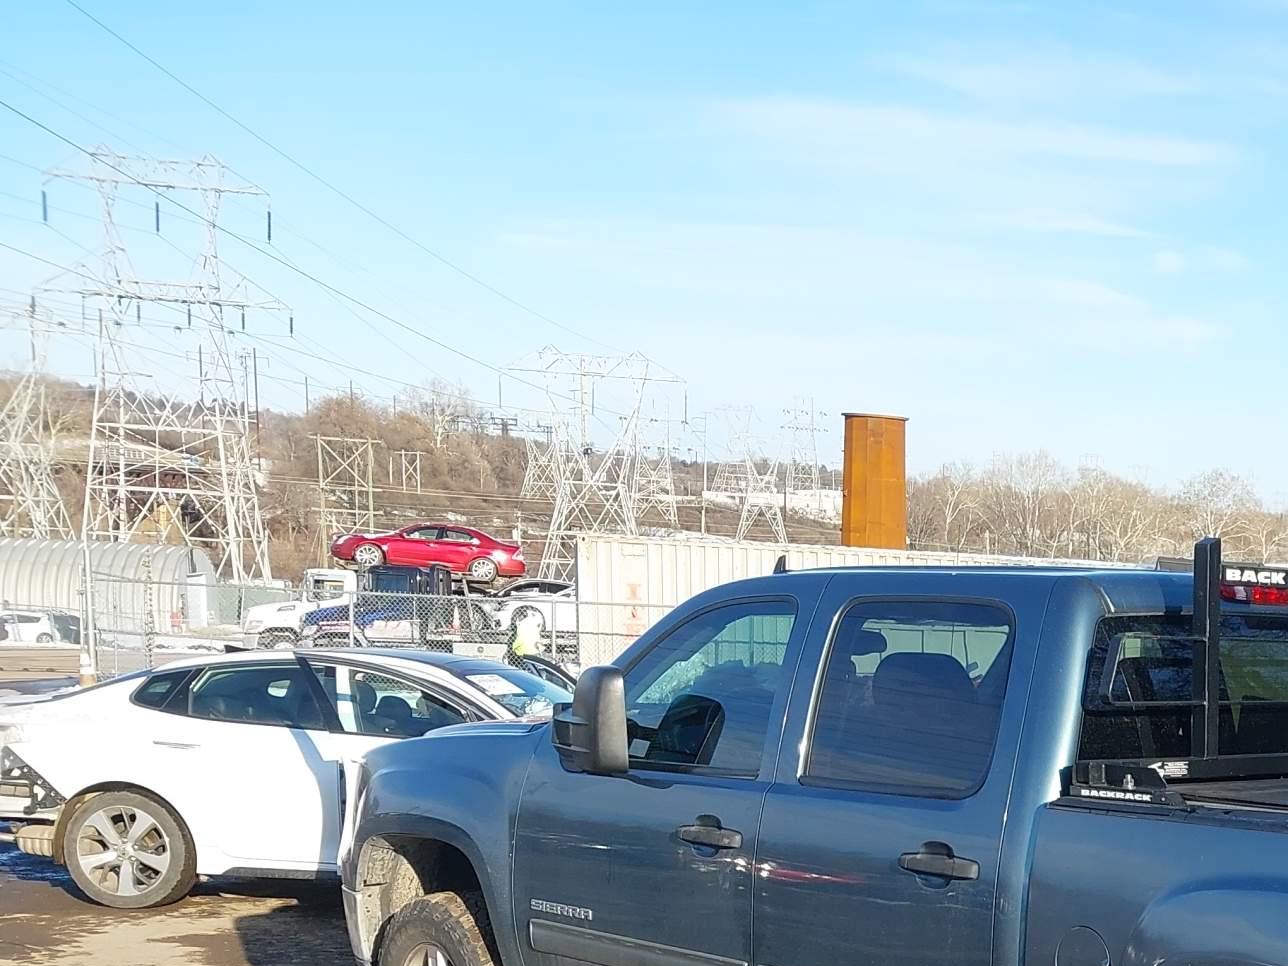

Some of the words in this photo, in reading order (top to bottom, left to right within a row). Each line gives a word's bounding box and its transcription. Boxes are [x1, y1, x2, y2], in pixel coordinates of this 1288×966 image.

[1225, 567, 1287, 585] BACK
[1080, 788, 1153, 802] BACKRACK
[529, 898, 593, 921] SIERRA
